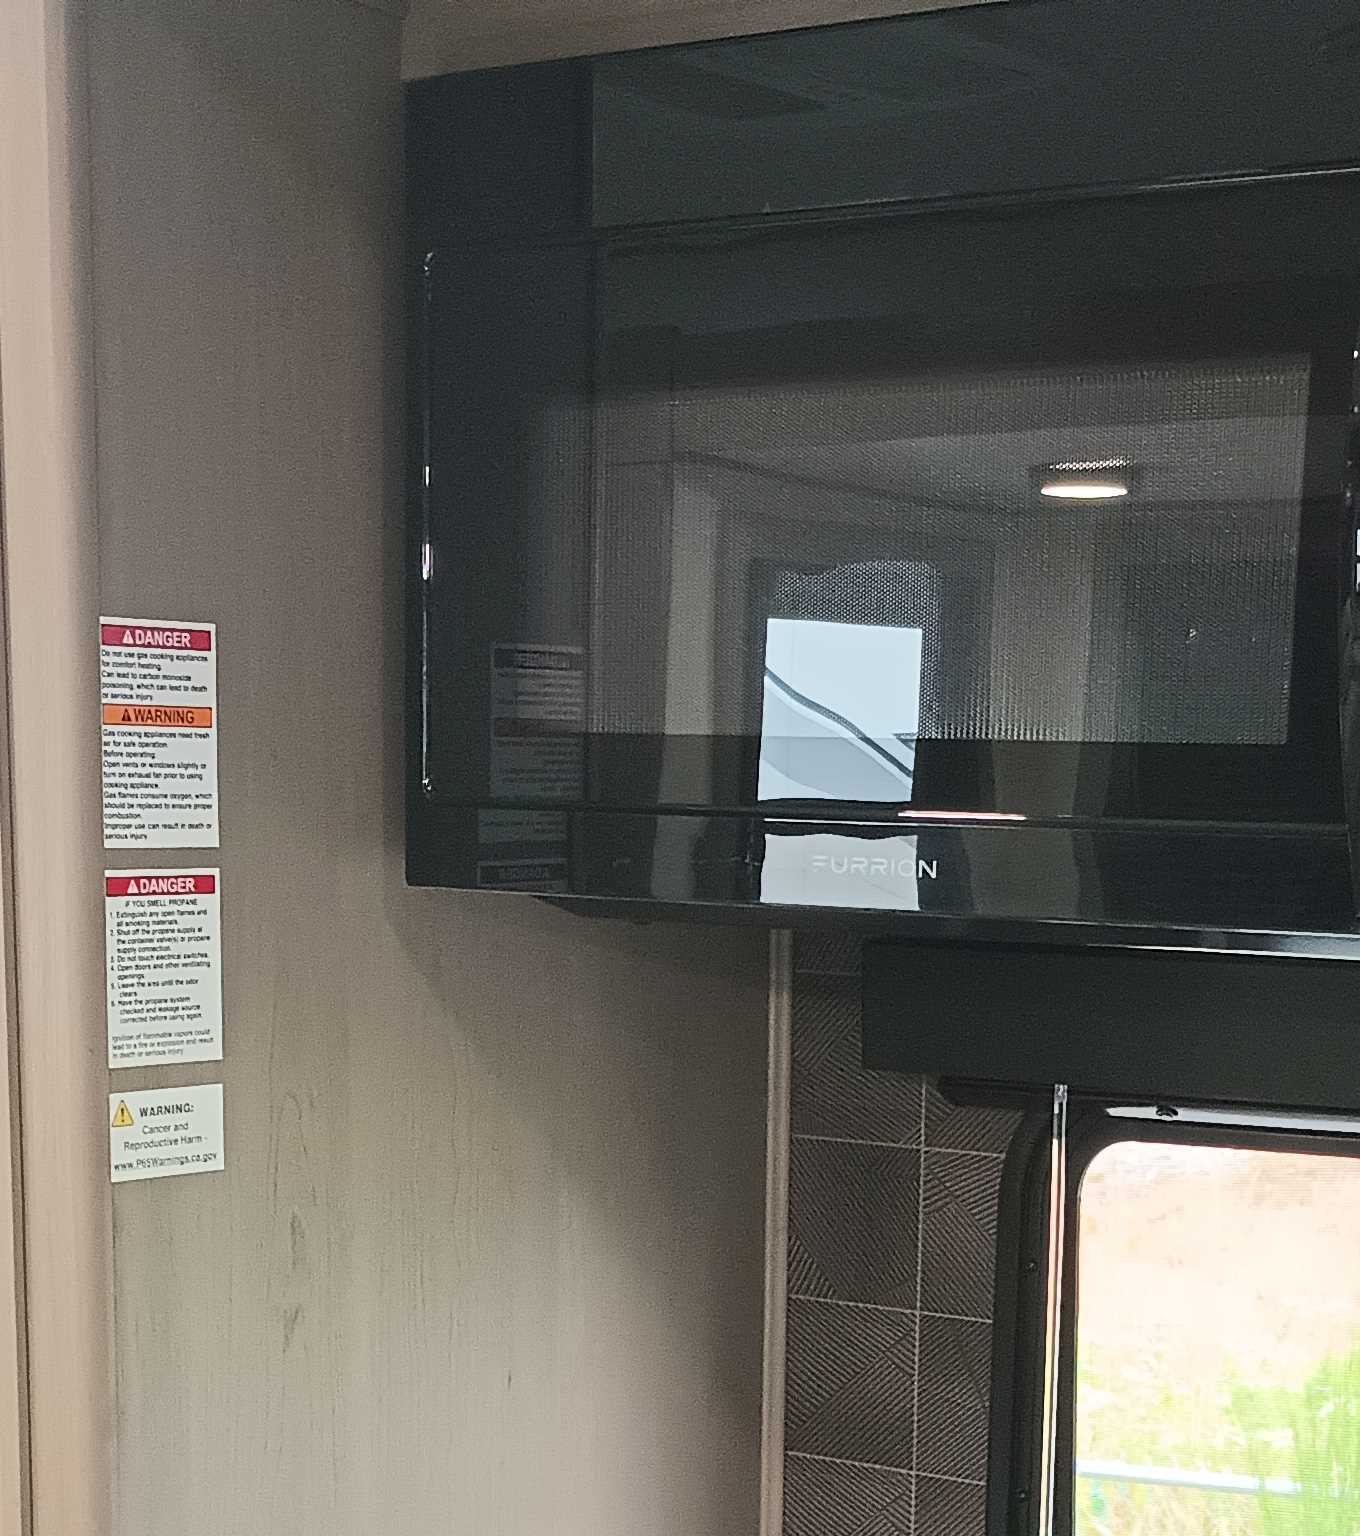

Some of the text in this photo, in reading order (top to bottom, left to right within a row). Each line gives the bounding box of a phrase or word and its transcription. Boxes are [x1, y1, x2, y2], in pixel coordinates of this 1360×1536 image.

[135, 629, 191, 648] DANGER
[150, 653, 174, 662] cooking
[133, 708, 196, 724] WARNING
[811, 855, 938, 879] FURRION
[139, 878, 196, 894] DANGER
[132, 900, 146, 908] YOU
[147, 899, 167, 907] SMELL
[169, 898, 199, 907] PROPANE
[139, 1103, 195, 1118] WARNING:
[142, 1121, 189, 1135] Cancer and
[124, 1134, 203, 1151] Reproductive Harm
[113, 1151, 217, 1171] www.P65Warnings.ca.gov
